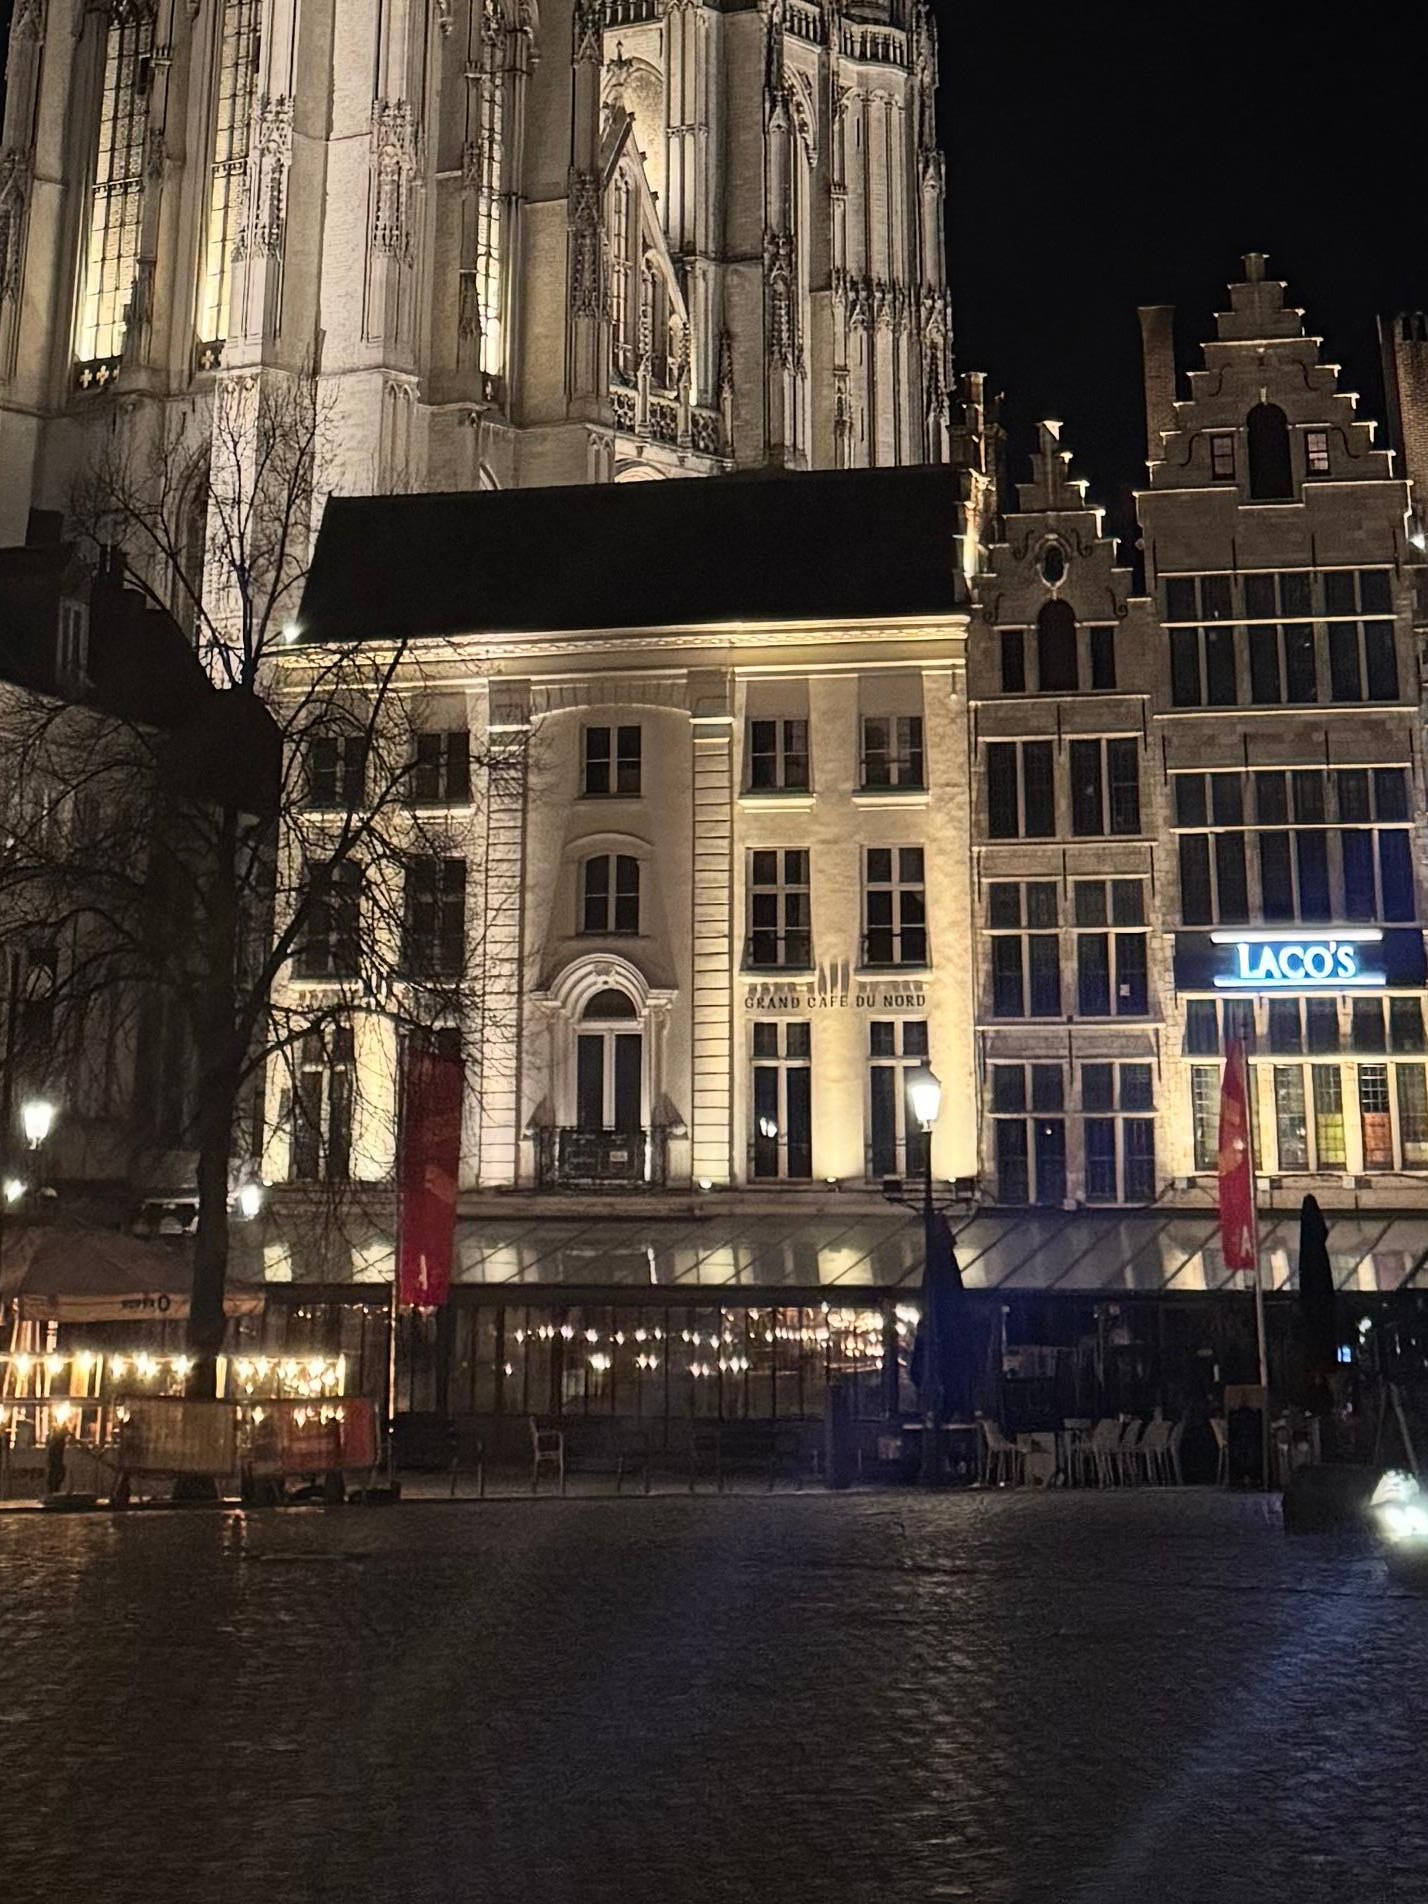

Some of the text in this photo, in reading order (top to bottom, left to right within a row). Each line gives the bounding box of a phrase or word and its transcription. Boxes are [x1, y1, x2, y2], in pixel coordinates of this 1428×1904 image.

[1236, 941, 1357, 979] LACO'S
[744, 996, 801, 1009] GRAND
[856, 995, 876, 1008] DU
[883, 994, 926, 1008] NORD
